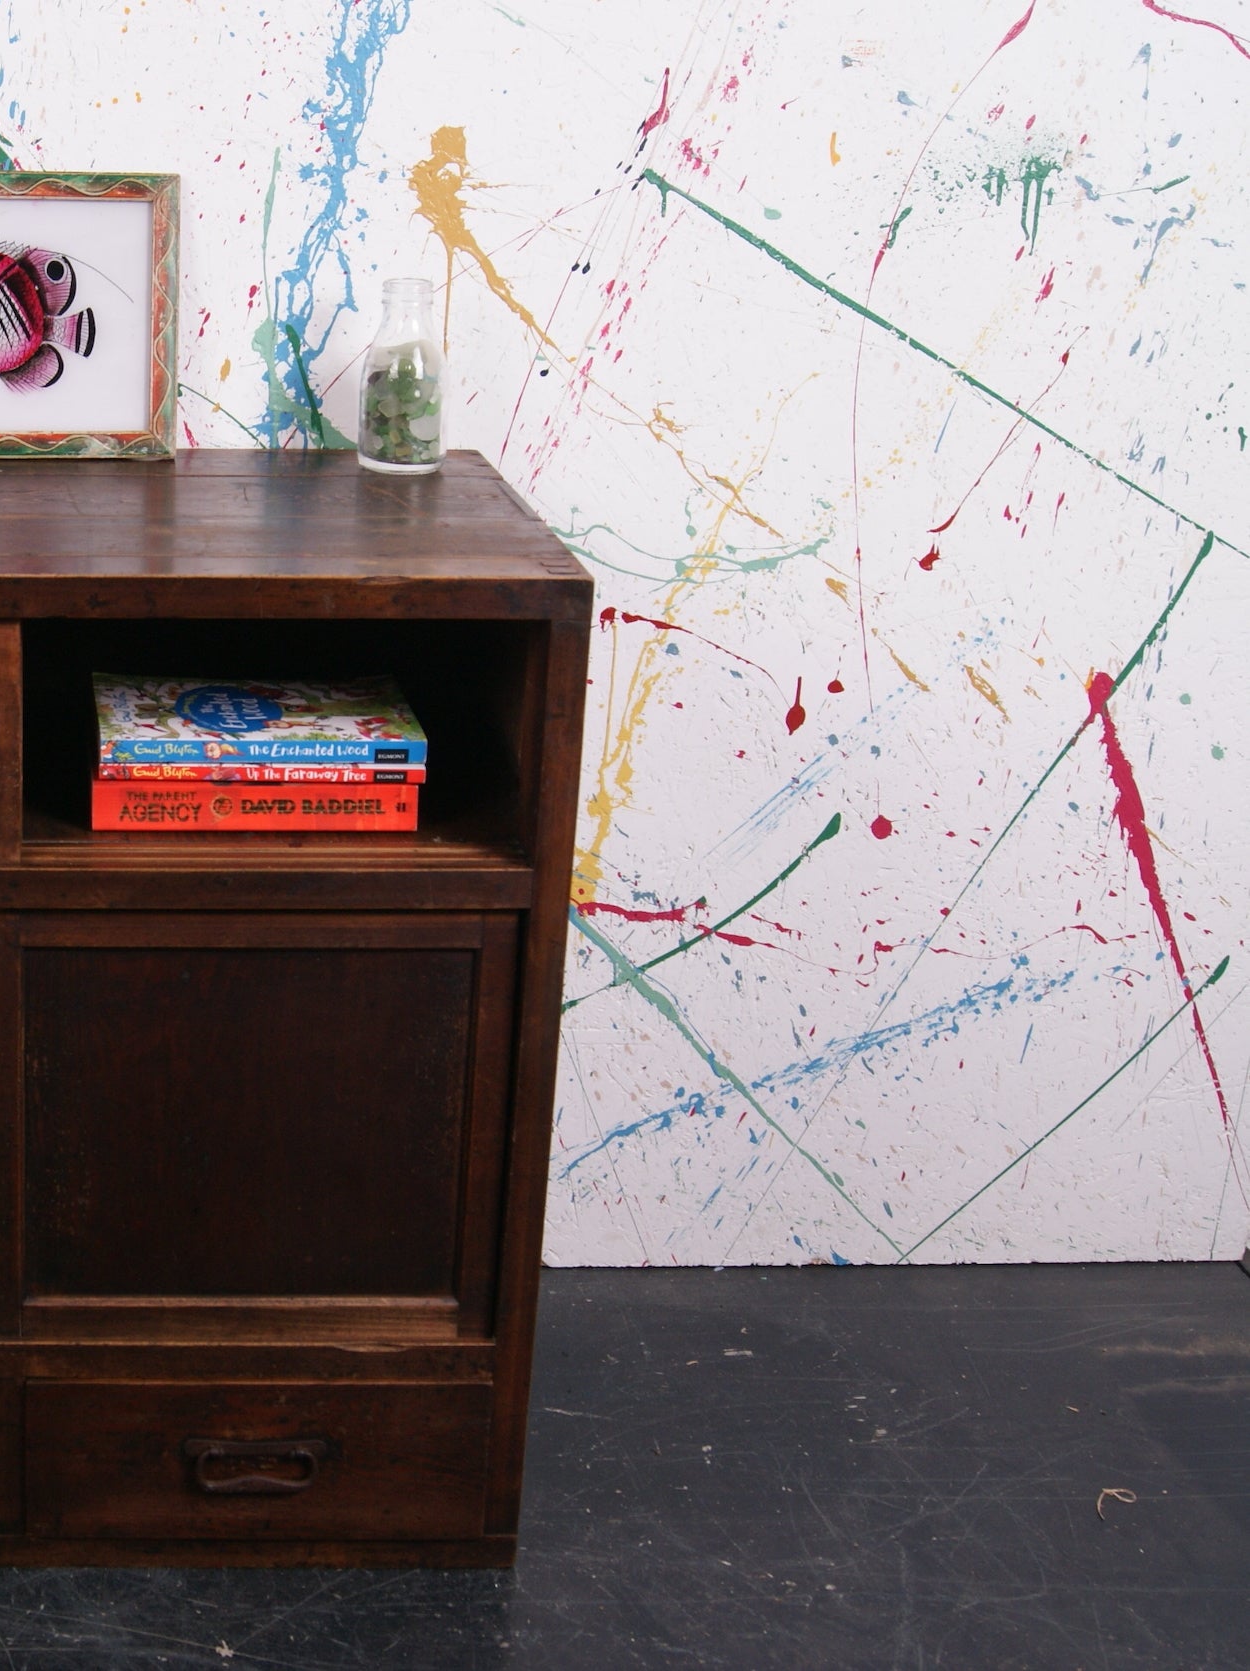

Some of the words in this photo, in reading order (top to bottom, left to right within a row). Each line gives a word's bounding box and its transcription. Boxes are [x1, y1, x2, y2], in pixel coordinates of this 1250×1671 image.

[134, 743, 162, 756] Enid
[164, 743, 199, 756] Blyton
[248, 744, 269, 756] The
[271, 743, 334, 757] Enchanted
[337, 744, 369, 756] Wood
[133, 766, 161, 778] Enid
[164, 766, 197, 778] Blyton
[246, 768, 260, 781] Up
[264, 768, 280, 780] The
[284, 768, 338, 782] Faraway
[342, 769, 367, 781] Tree
[126, 791, 149, 801] THE
[152, 791, 197, 801] PARENT
[119, 802, 202, 822] AGENCY
[240, 799, 296, 814] DAVID
[301, 799, 385, 815] BADDIEL
